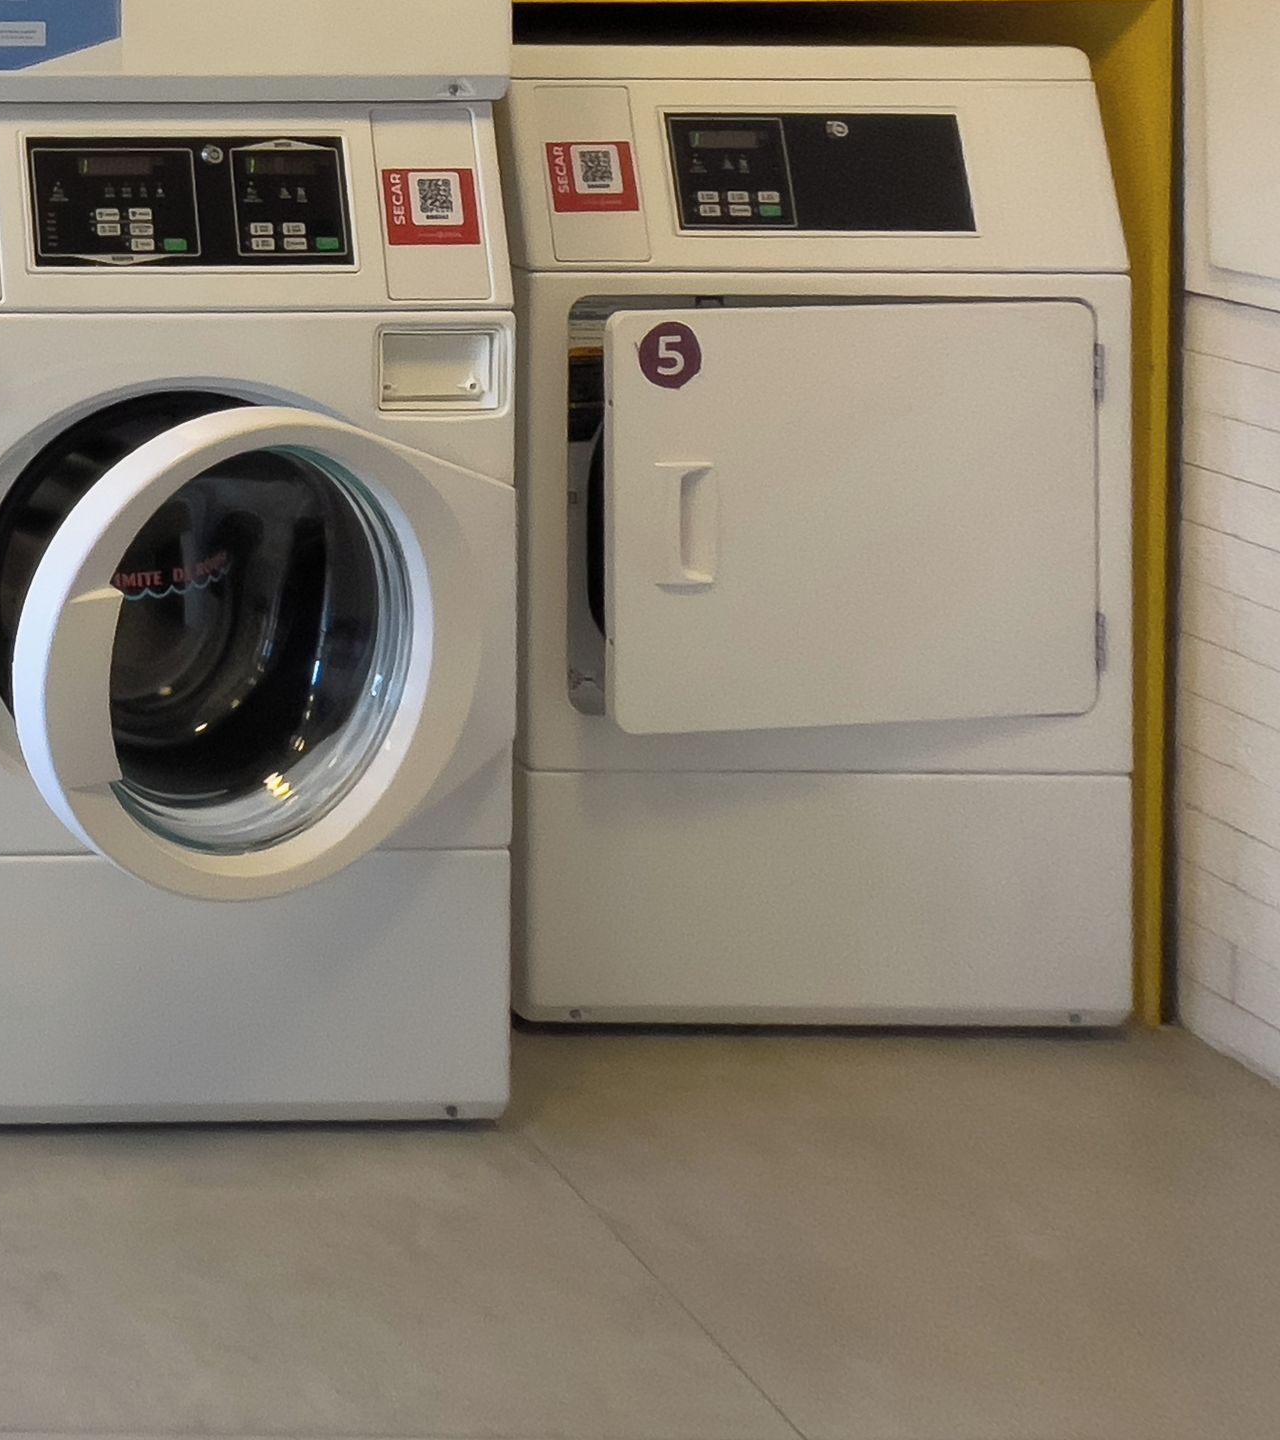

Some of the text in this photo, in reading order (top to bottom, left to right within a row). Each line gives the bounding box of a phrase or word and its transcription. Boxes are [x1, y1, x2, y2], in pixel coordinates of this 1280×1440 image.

[552, 145, 570, 194] SECAR
[390, 173, 405, 224] SECAR
[657, 335, 684, 375] 5
